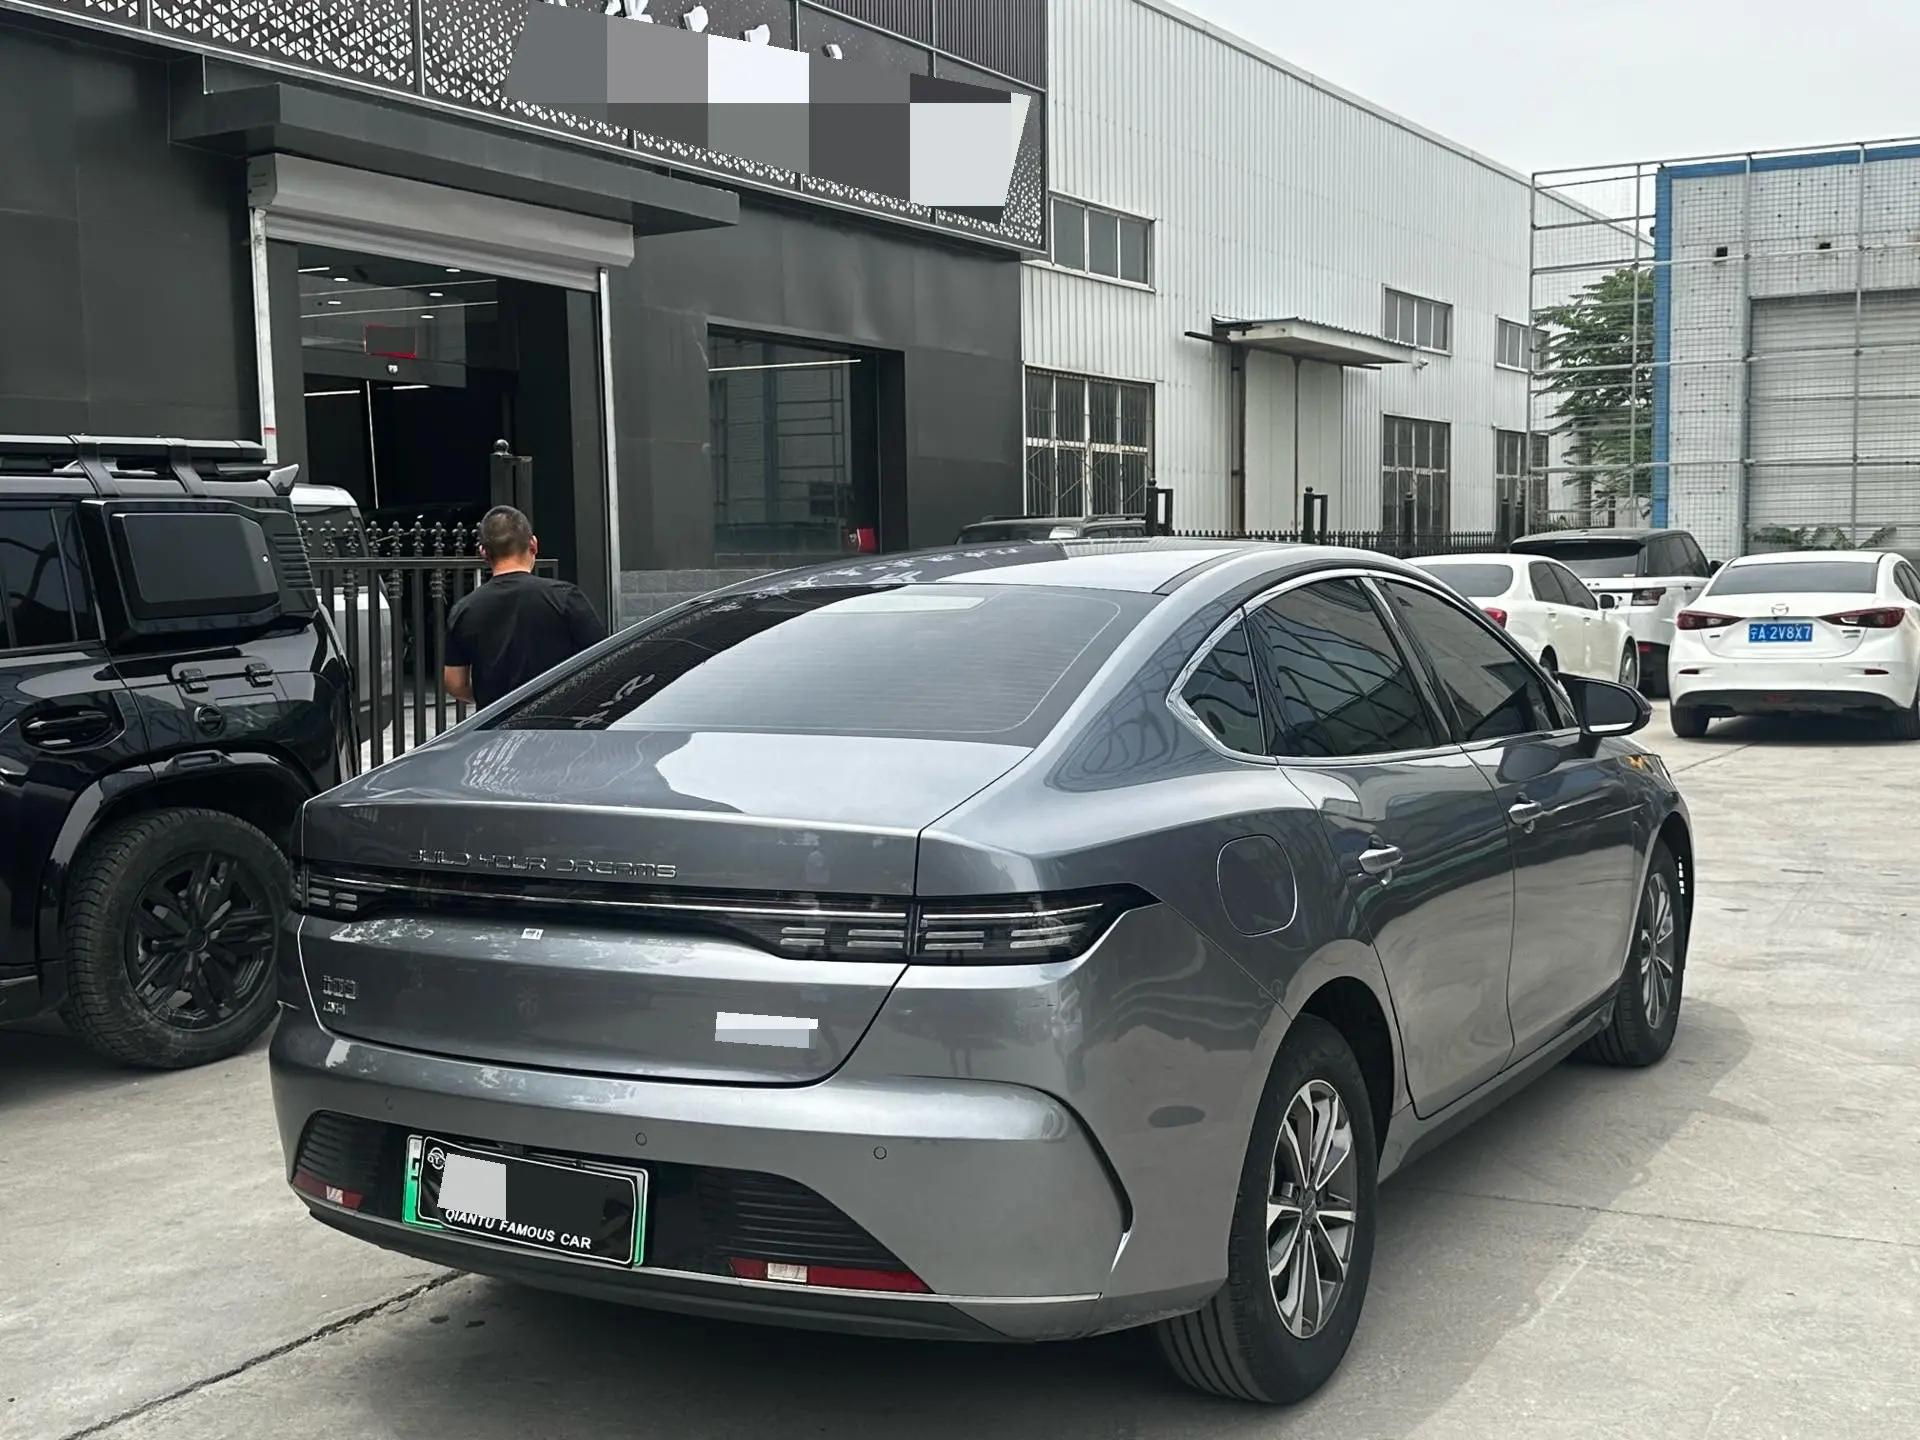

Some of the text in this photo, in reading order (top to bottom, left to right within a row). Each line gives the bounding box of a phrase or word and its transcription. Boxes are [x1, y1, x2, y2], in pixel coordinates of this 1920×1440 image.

[479, 853, 547, 871] YOUR
[556, 858, 677, 878] DREAMS
[445, 1209, 592, 1249] QIANTU FAMOUS CAR
